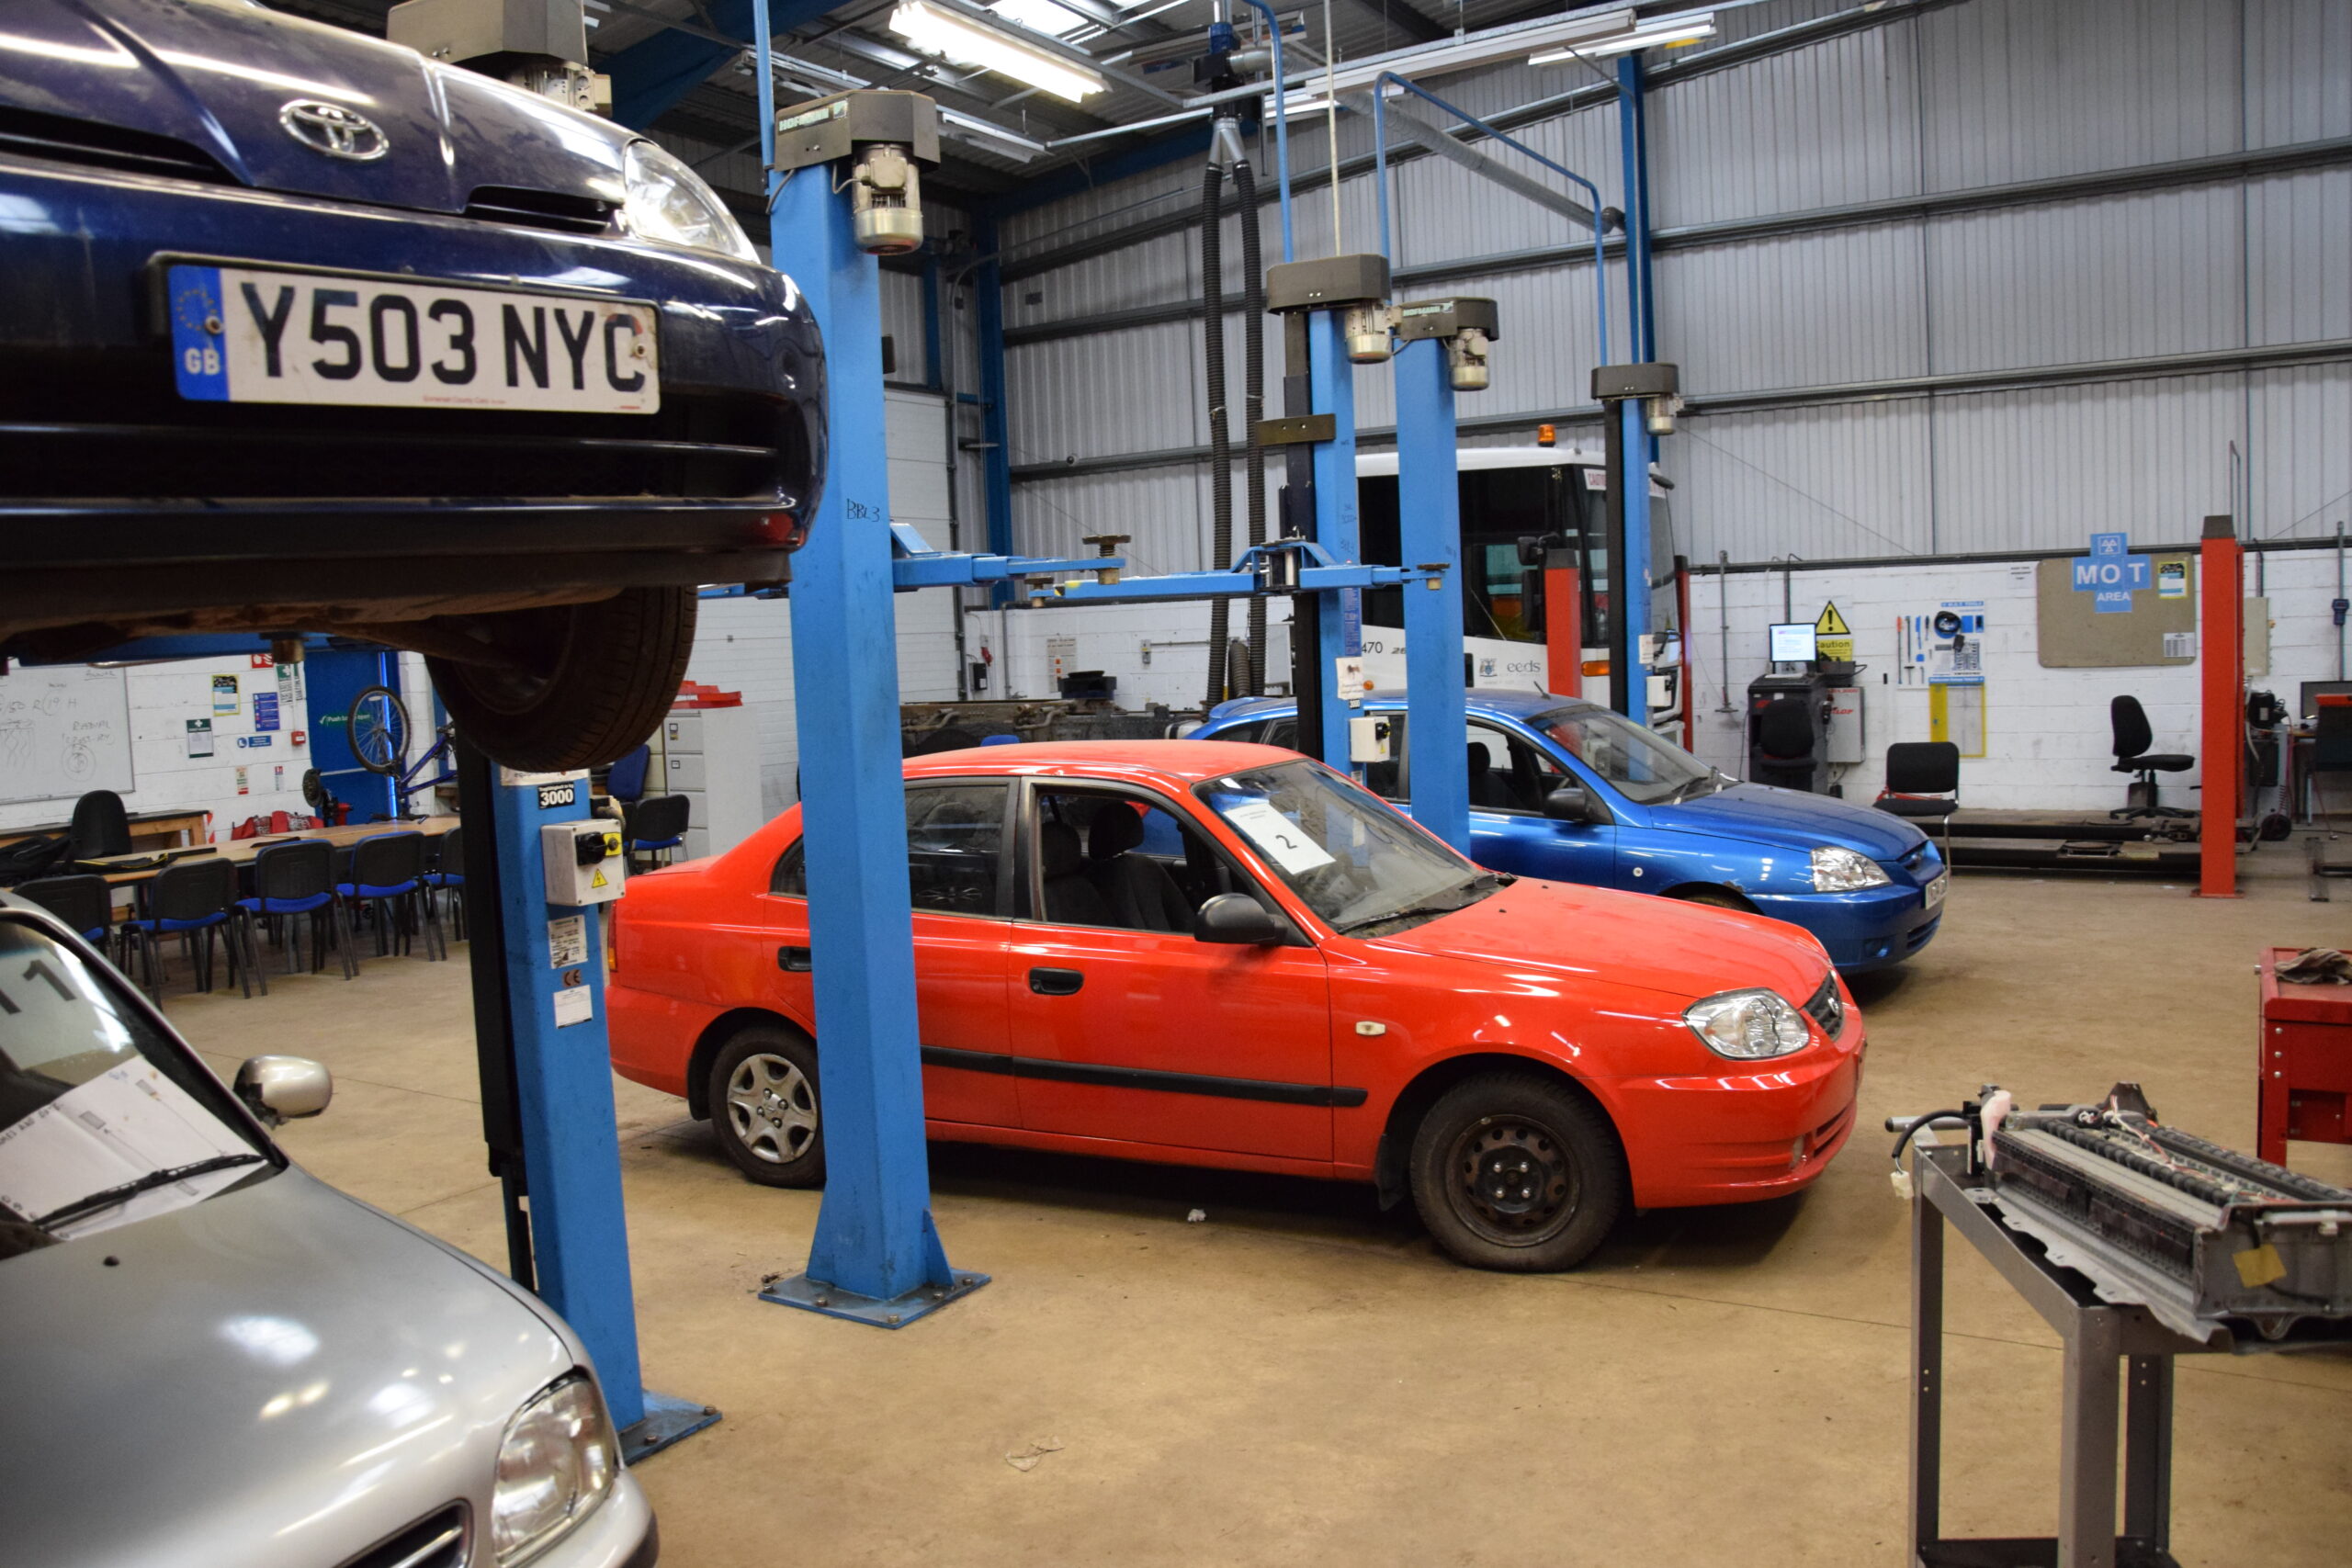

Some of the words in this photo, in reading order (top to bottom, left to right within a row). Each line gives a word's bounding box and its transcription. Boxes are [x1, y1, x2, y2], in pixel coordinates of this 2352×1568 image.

[241, 282, 477, 385] Y503
[502, 304, 646, 392] NYC
[186, 347, 220, 375] GB
[2076, 562, 2145, 584] MOT
[2097, 592, 2131, 602] AREA
[540, 789, 574, 807] 3000
[1275, 834, 1298, 850] 2
